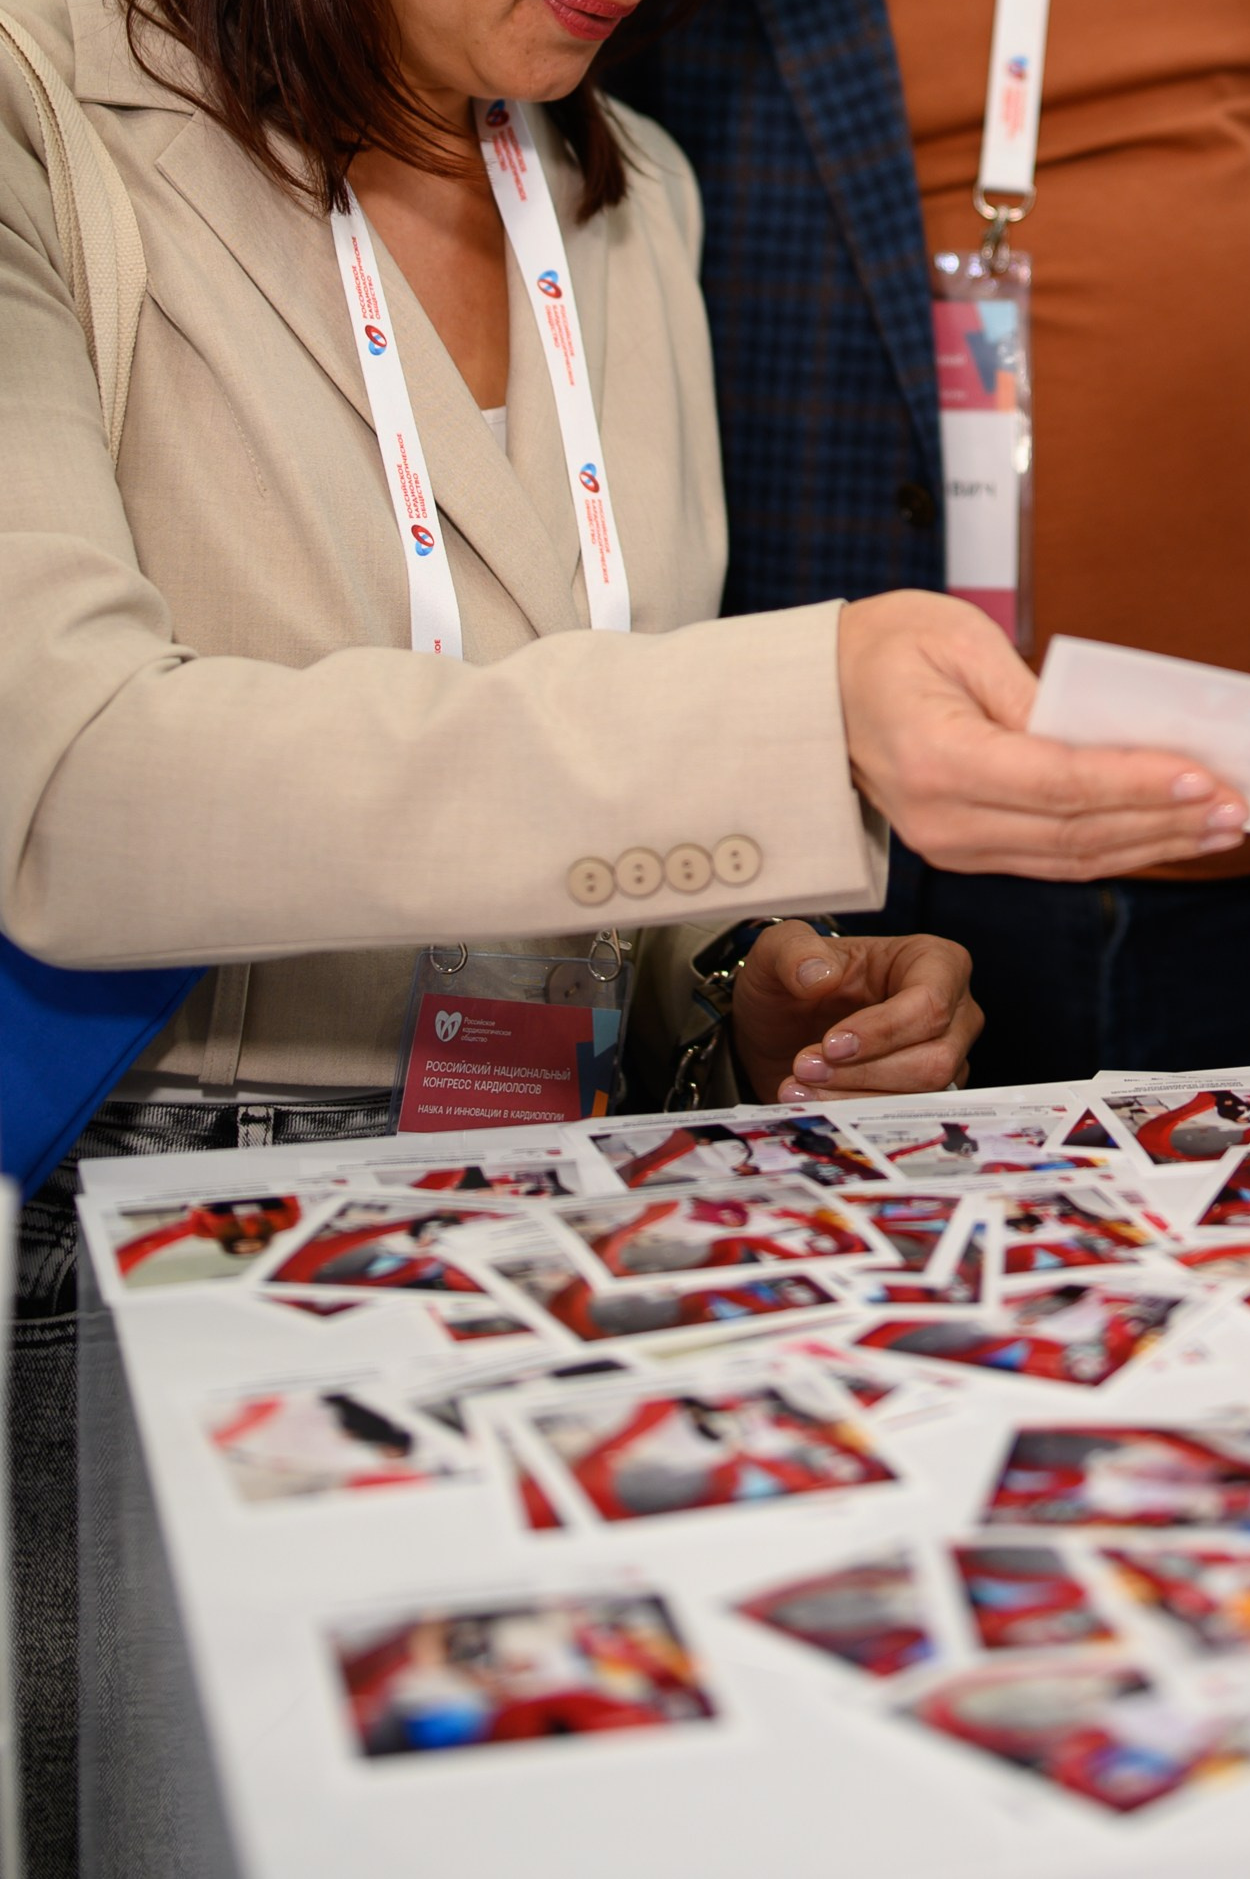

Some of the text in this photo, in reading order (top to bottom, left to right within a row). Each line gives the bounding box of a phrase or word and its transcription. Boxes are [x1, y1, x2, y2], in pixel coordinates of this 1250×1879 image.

[397, 433, 421, 519] КАРДИОЛОГИЧЕСКОЕ
[397, 464, 414, 519] РОССИЙСКОЕ
[413, 472, 428, 519] ОБЩЕСТВО
[422, 1076, 542, 1095] КОНГРЕСС КАРДИОЛОГОВ
[425, 1059, 571, 1081] РОССИЙСКИЙ НАЦИОНАЛЬНЫЙ
[418, 1104, 565, 1121] НАУКА И ИННОВАЦИИ В КАРДИОЛОГИИ
